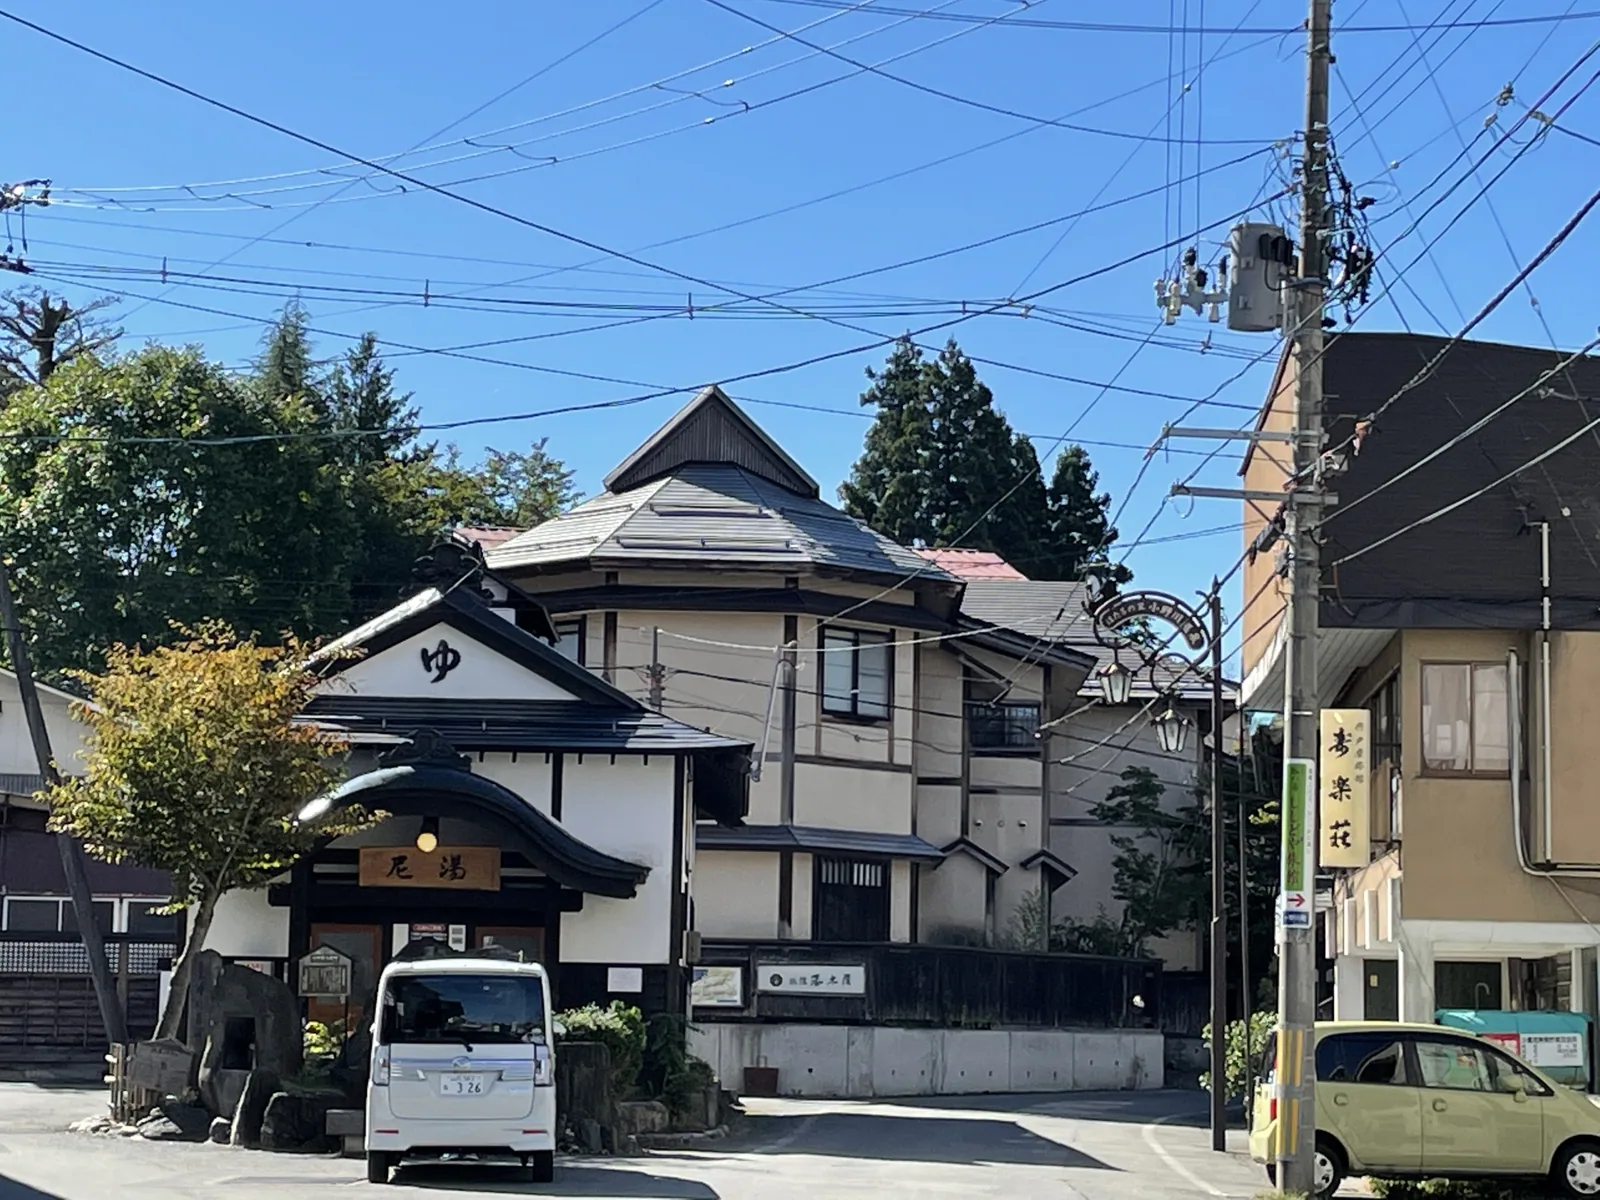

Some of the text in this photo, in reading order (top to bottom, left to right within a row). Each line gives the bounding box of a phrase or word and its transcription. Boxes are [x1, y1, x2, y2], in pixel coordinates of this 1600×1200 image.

[420, 639, 462, 684] ゆ
[1328, 727, 1353, 849] 寿楽荘
[386, 854, 467, 881] 尼湯
